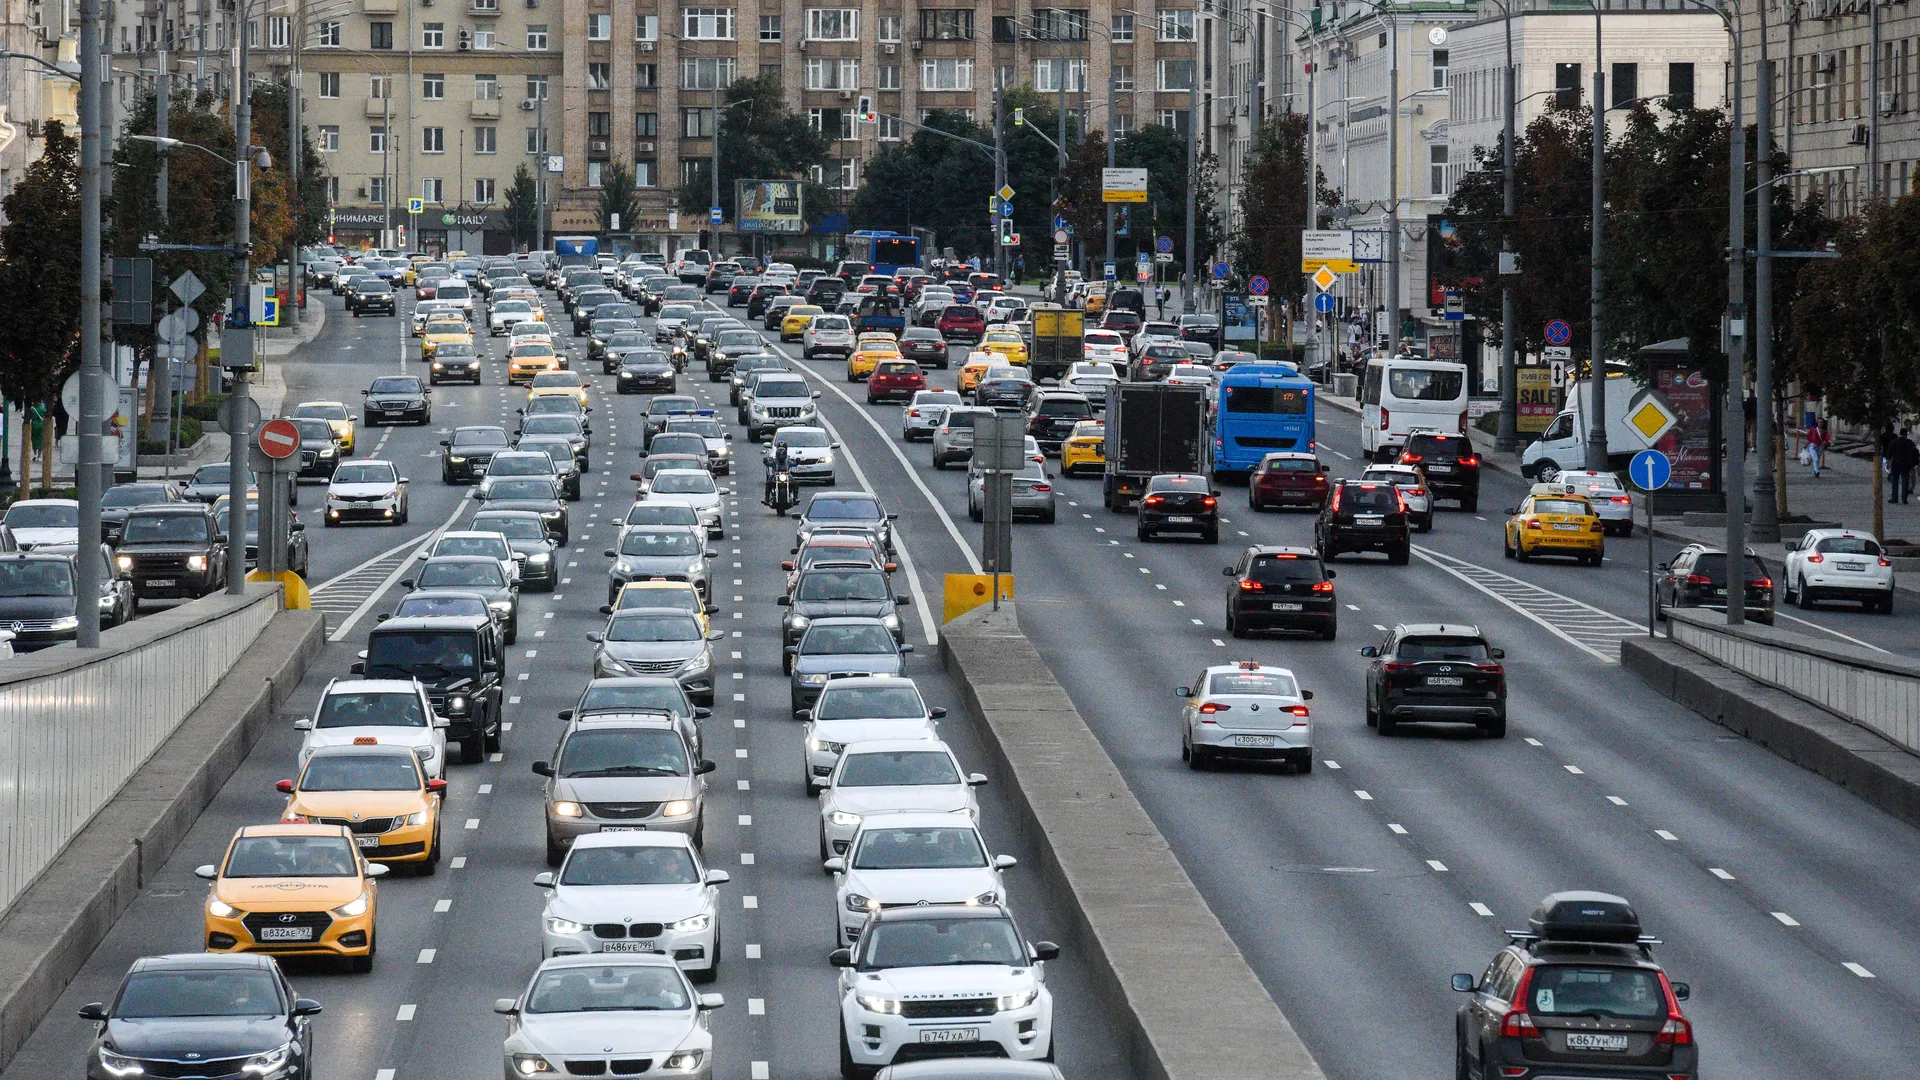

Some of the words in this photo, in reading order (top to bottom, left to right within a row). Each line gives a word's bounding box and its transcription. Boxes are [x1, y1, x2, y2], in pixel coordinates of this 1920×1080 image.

[323, 214, 391, 223] ИНИМАРКЕ
[457, 215, 487, 225] DAILY
[1520, 388, 1556, 405] SALE
[1547, 485, 1565, 493] Яндекс
